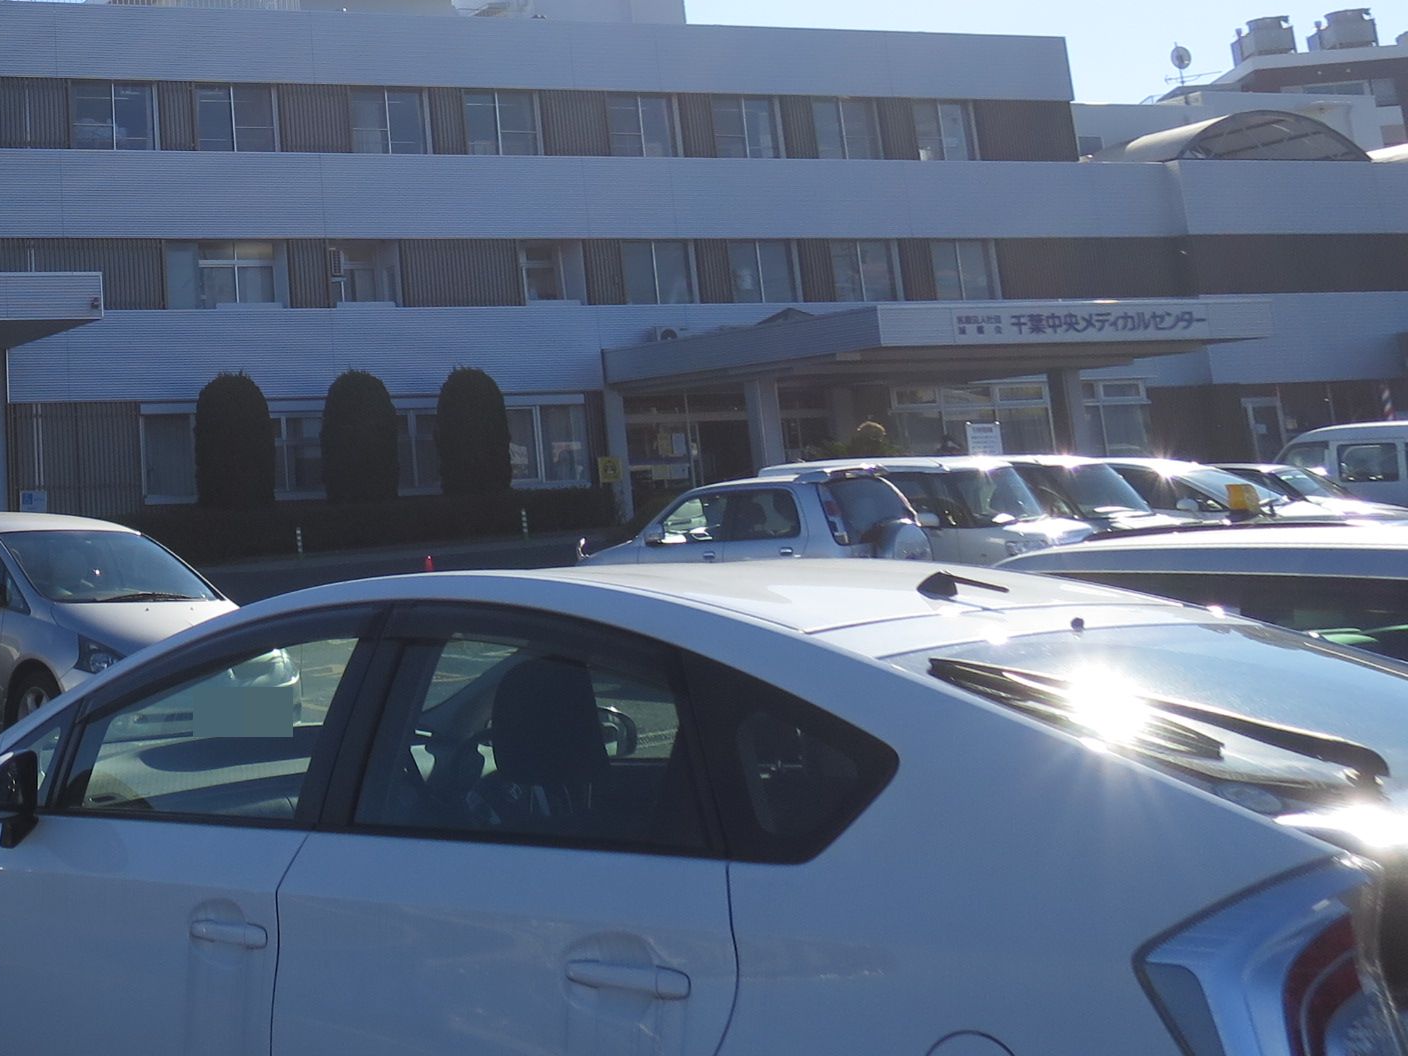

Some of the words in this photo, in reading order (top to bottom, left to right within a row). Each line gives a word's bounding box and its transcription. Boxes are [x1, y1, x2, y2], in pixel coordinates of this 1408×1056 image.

[1010, 312, 1206, 335] 千葉中央メディカルセンター
